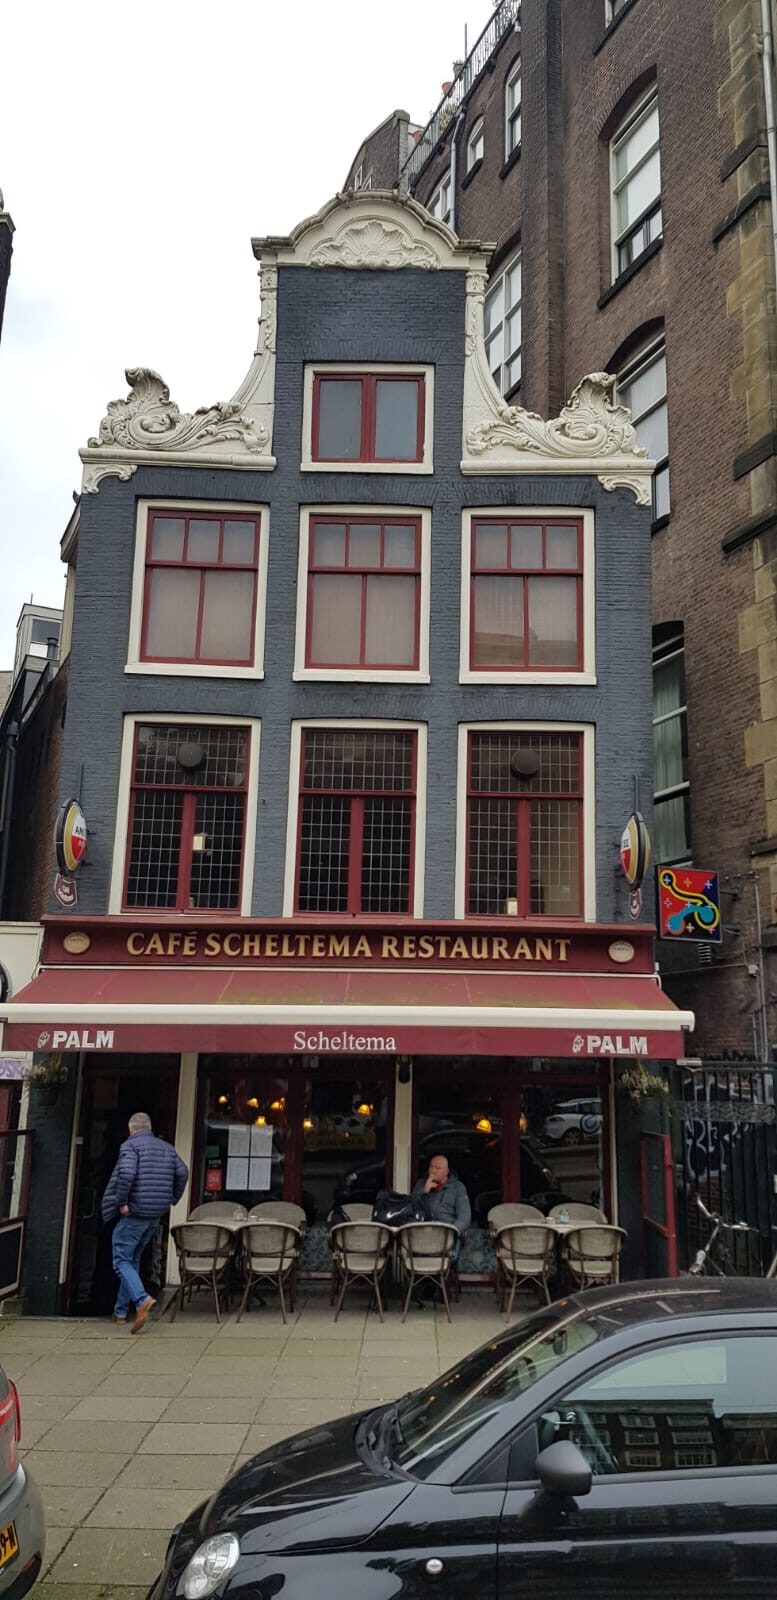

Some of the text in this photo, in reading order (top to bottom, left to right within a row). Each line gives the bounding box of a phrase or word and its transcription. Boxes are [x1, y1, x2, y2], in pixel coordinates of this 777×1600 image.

[127, 931, 571, 961] CAFÉ SCHELTEMA RESTAURANT
[52, 1030, 115, 1049] PALM
[293, 1031, 397, 1050] Scheltema
[587, 1035, 648, 1055] PALM
